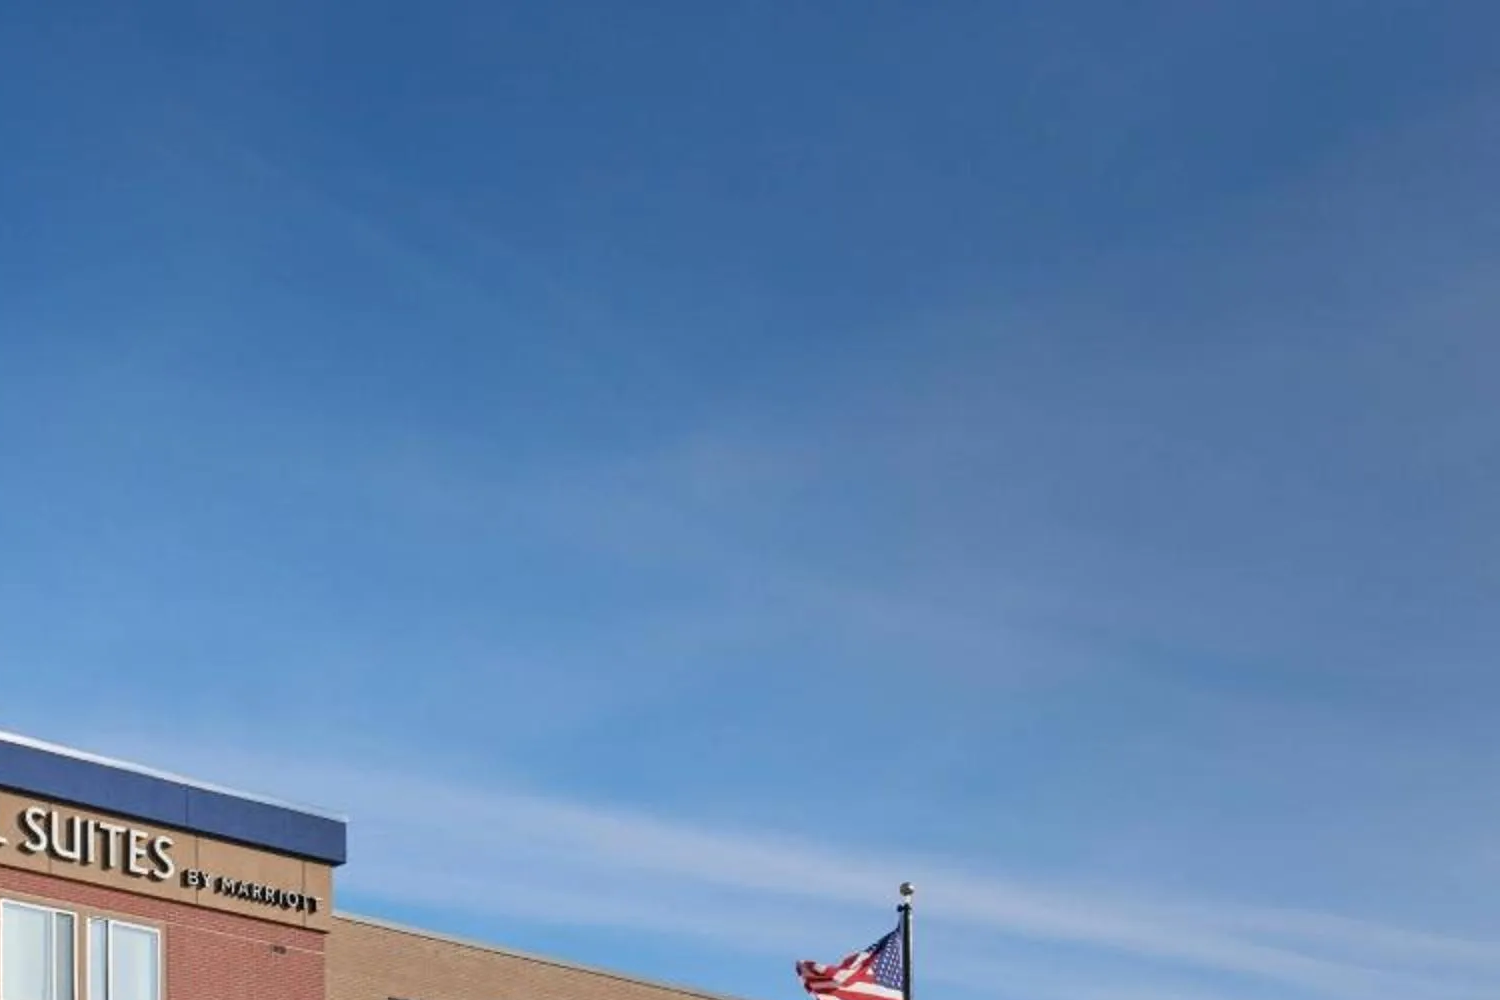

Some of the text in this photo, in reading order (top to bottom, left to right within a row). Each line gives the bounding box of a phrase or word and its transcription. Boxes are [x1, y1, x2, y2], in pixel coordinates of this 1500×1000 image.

[24, 806, 175, 880] SUITES
[187, 869, 211, 889] BY
[221, 877, 324, 909] MARRIOTT
